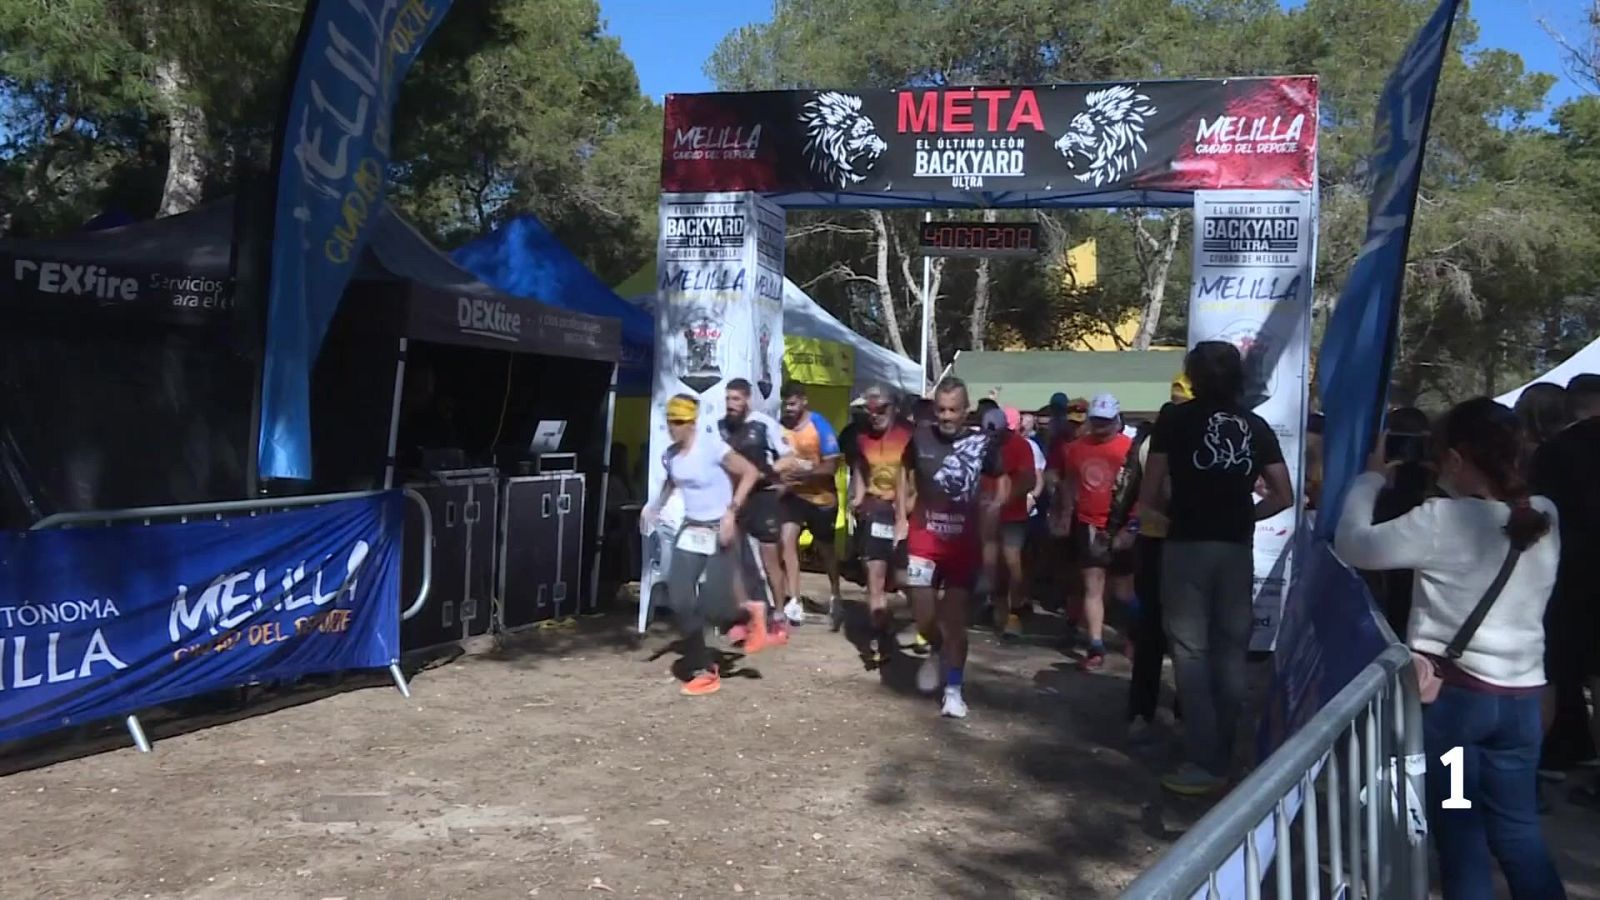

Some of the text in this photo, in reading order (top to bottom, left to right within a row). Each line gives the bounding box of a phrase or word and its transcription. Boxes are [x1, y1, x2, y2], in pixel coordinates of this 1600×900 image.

[897, 89, 1046, 133] META
[673, 123, 762, 149] MELILLA
[1196, 113, 1305, 143] MELILLA
[916, 136, 1025, 150] EL ÚLTIMO LEÓN
[1195, 142, 1299, 154] CIUDAD DEL DEPORTE
[915, 150, 1024, 175] BACKYARD
[951, 176, 983, 188] ULTRA
[1213, 206, 1224, 215] EL
[667, 219, 744, 236] BACKYARD
[1204, 220, 1298, 239] BACKYARD
[688, 236, 721, 247] ULTRA
[1230, 240, 1269, 250] ULTRA
[662, 268, 745, 291] MELILLA
[1197, 275, 1301, 300] MELILLA
[458, 298, 521, 333] DEXfire
[249, 622, 289, 646] DEL
